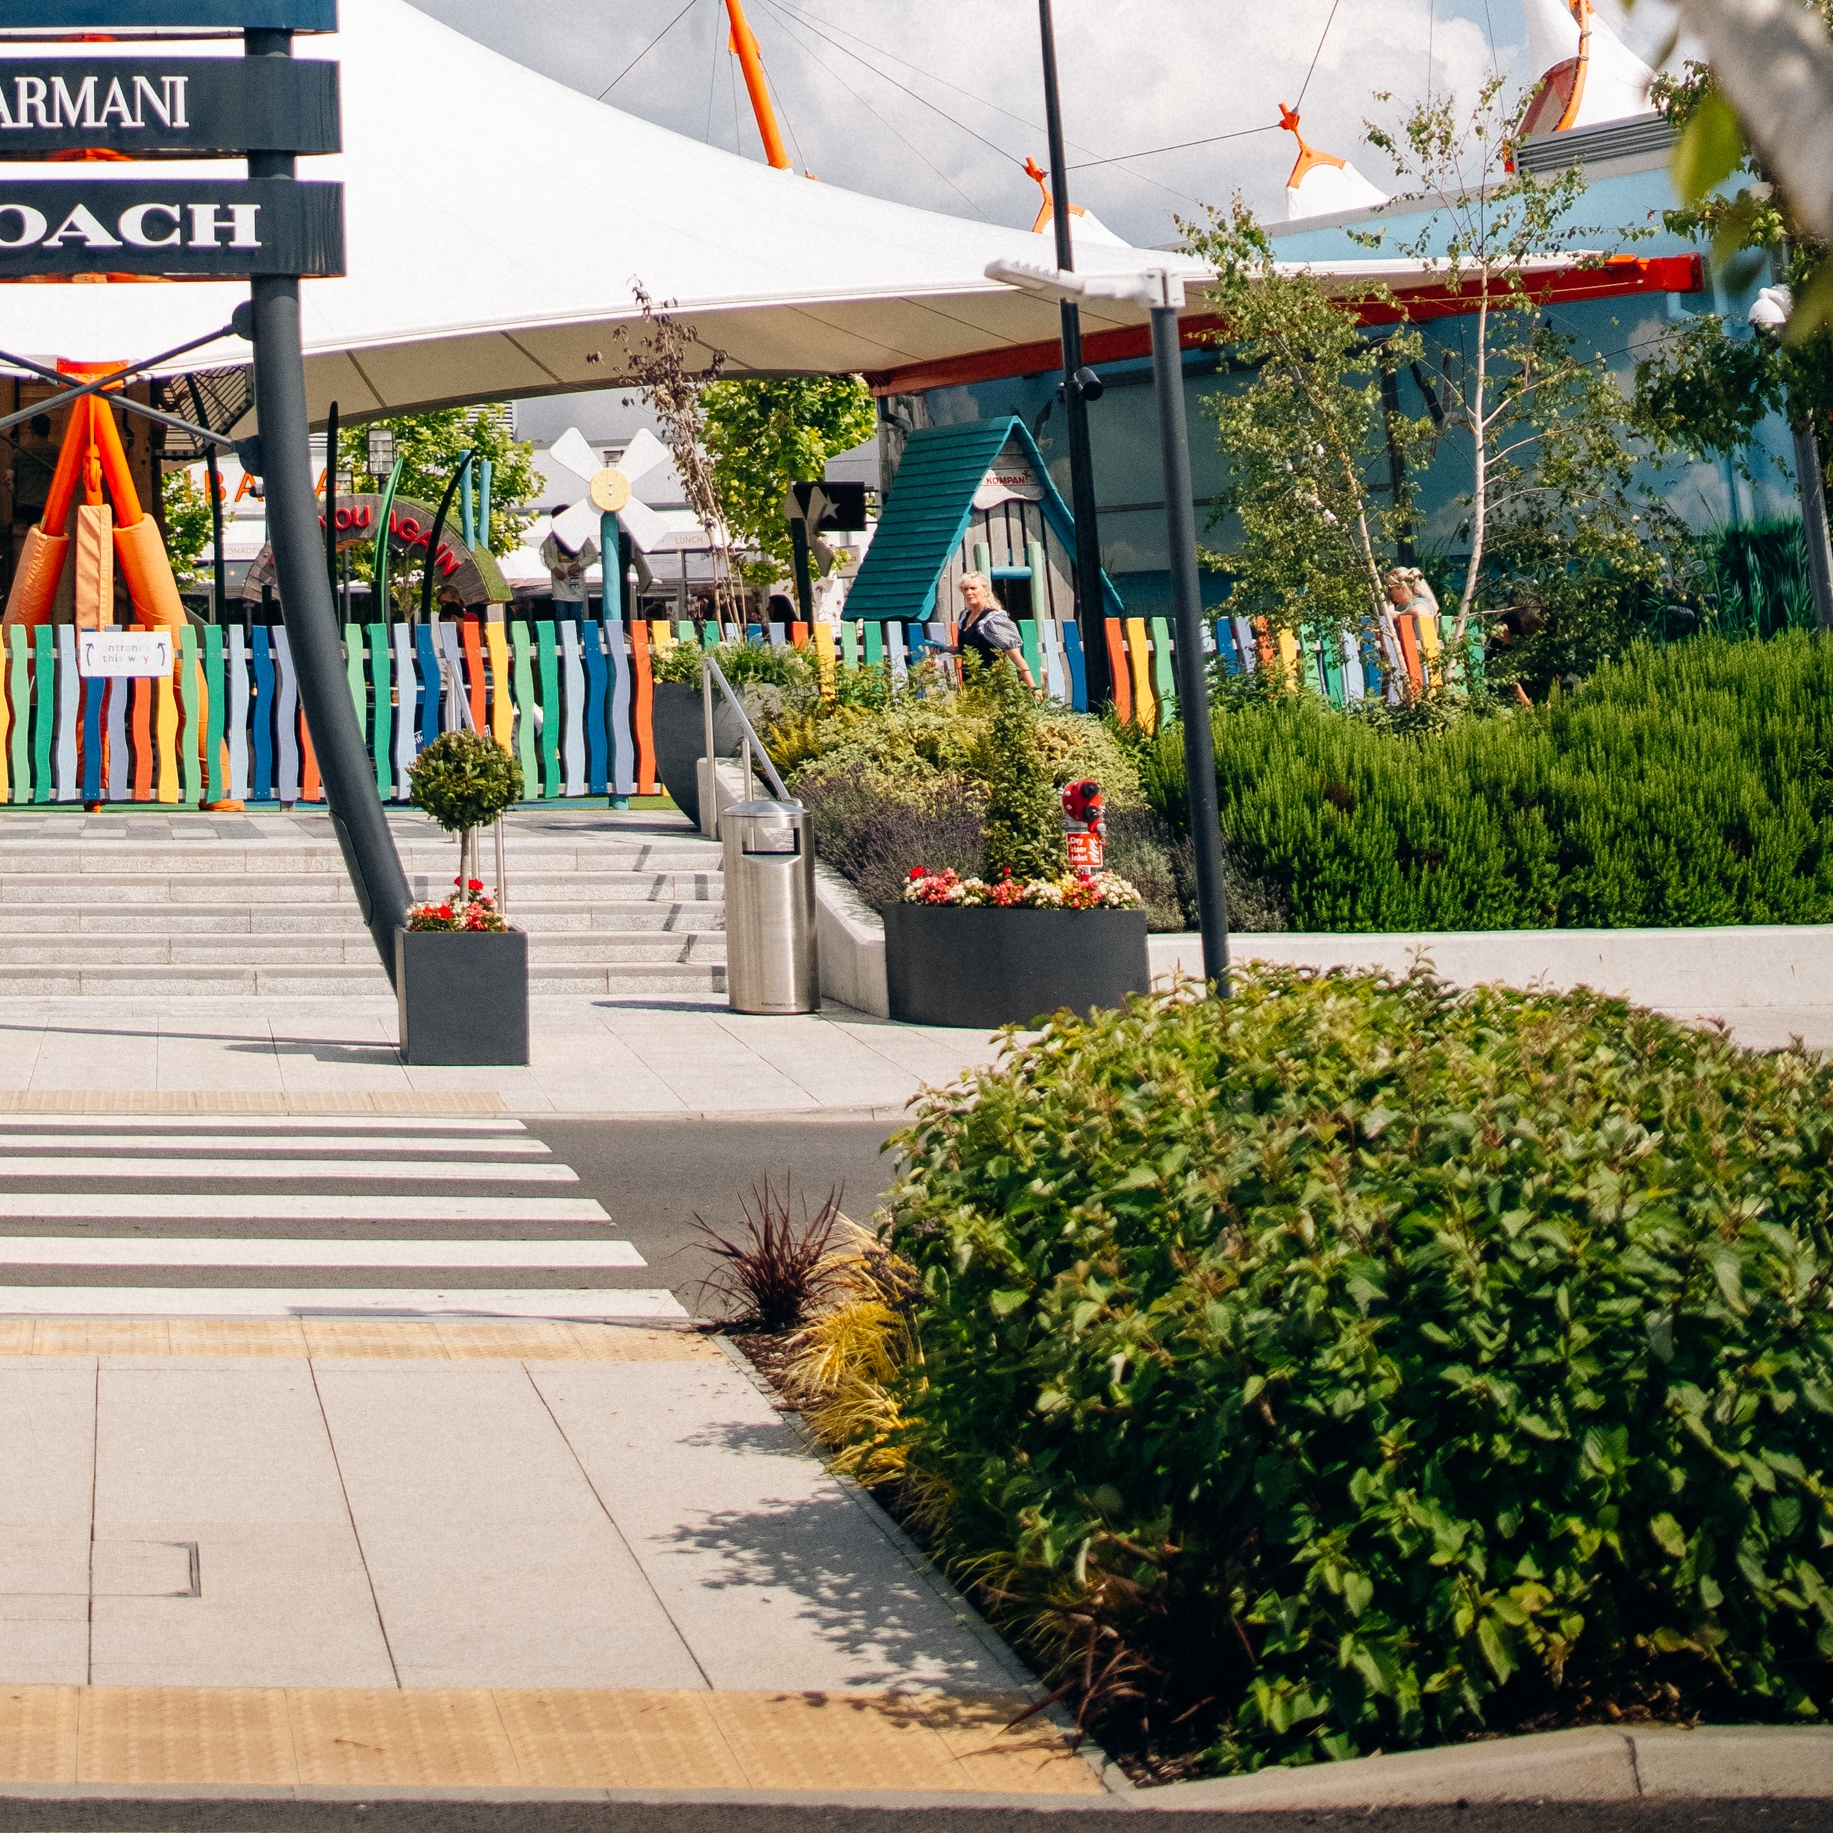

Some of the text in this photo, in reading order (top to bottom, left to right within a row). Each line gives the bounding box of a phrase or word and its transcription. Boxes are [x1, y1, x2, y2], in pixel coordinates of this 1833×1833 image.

[675, 535, 703, 544] LUNCH
[210, 547, 261, 555] LONADES
[101, 644, 151, 652] Entrance
[103, 653, 150, 664] this way
[1070, 836, 1084, 846] Dry
